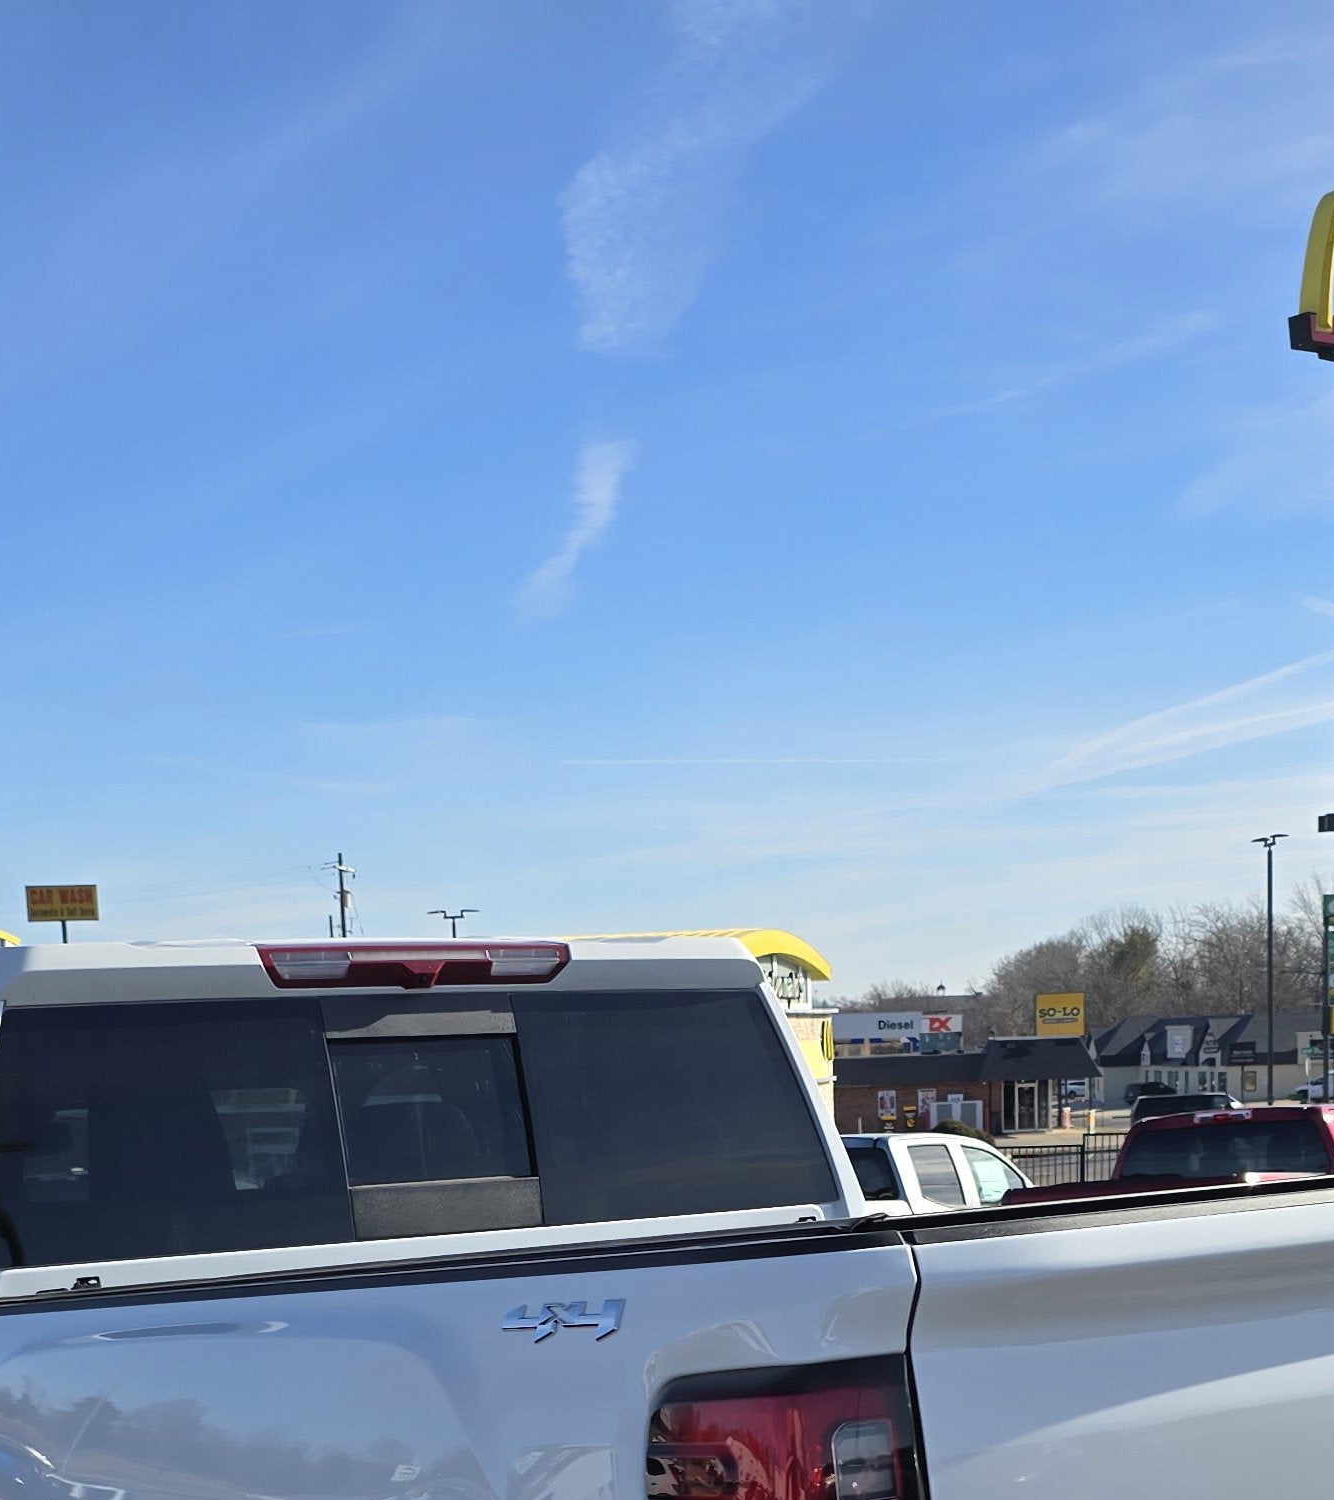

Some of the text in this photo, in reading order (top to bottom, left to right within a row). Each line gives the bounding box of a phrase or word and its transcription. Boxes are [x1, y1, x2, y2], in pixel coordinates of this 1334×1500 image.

[31, 888, 93, 905] CAR WASH
[1039, 1006, 1081, 1018] SO-LO
[877, 1019, 914, 1031] Diesel
